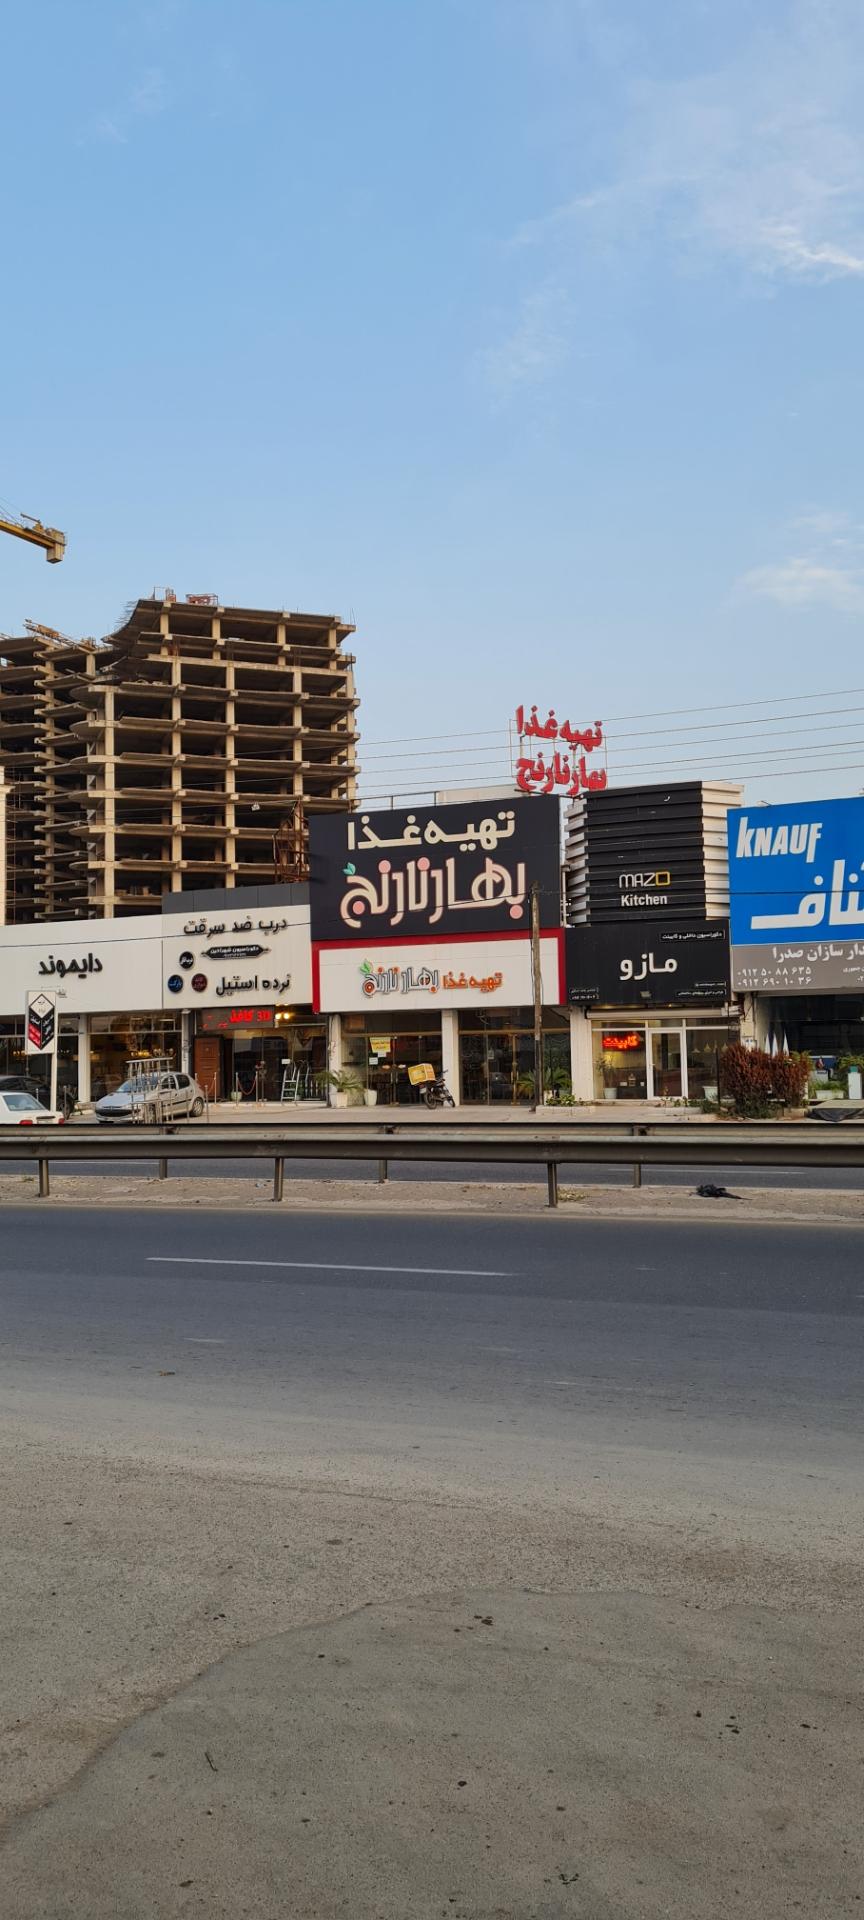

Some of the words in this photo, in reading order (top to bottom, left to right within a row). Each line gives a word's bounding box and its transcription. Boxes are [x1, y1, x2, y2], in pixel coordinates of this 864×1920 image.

[516, 704, 558, 739] غذا
[560, 720, 602, 752] تهیه
[347, 815, 422, 851] غذا
[424, 811, 515, 852] تهیه
[619, 871, 671, 889] MAZO
[620, 894, 668, 907] Kitchen
[183, 917, 226, 938] سرقت
[231, 915, 252, 933] ضد
[258, 918, 288, 936] درب
[772, 946, 804, 963] صدرا
[806, 943, 844, 962] سازان
[38, 953, 103, 979] دایموند
[619, 952, 678, 981] مازو
[775, 967, 789, 976] ۸۸
[215, 974, 258, 997] استیل
[262, 973, 291, 993] نرده
[442, 971, 468, 989] غذا
[468, 972, 503, 993] تهیه
[784, 977, 794, 985] ۱۰
